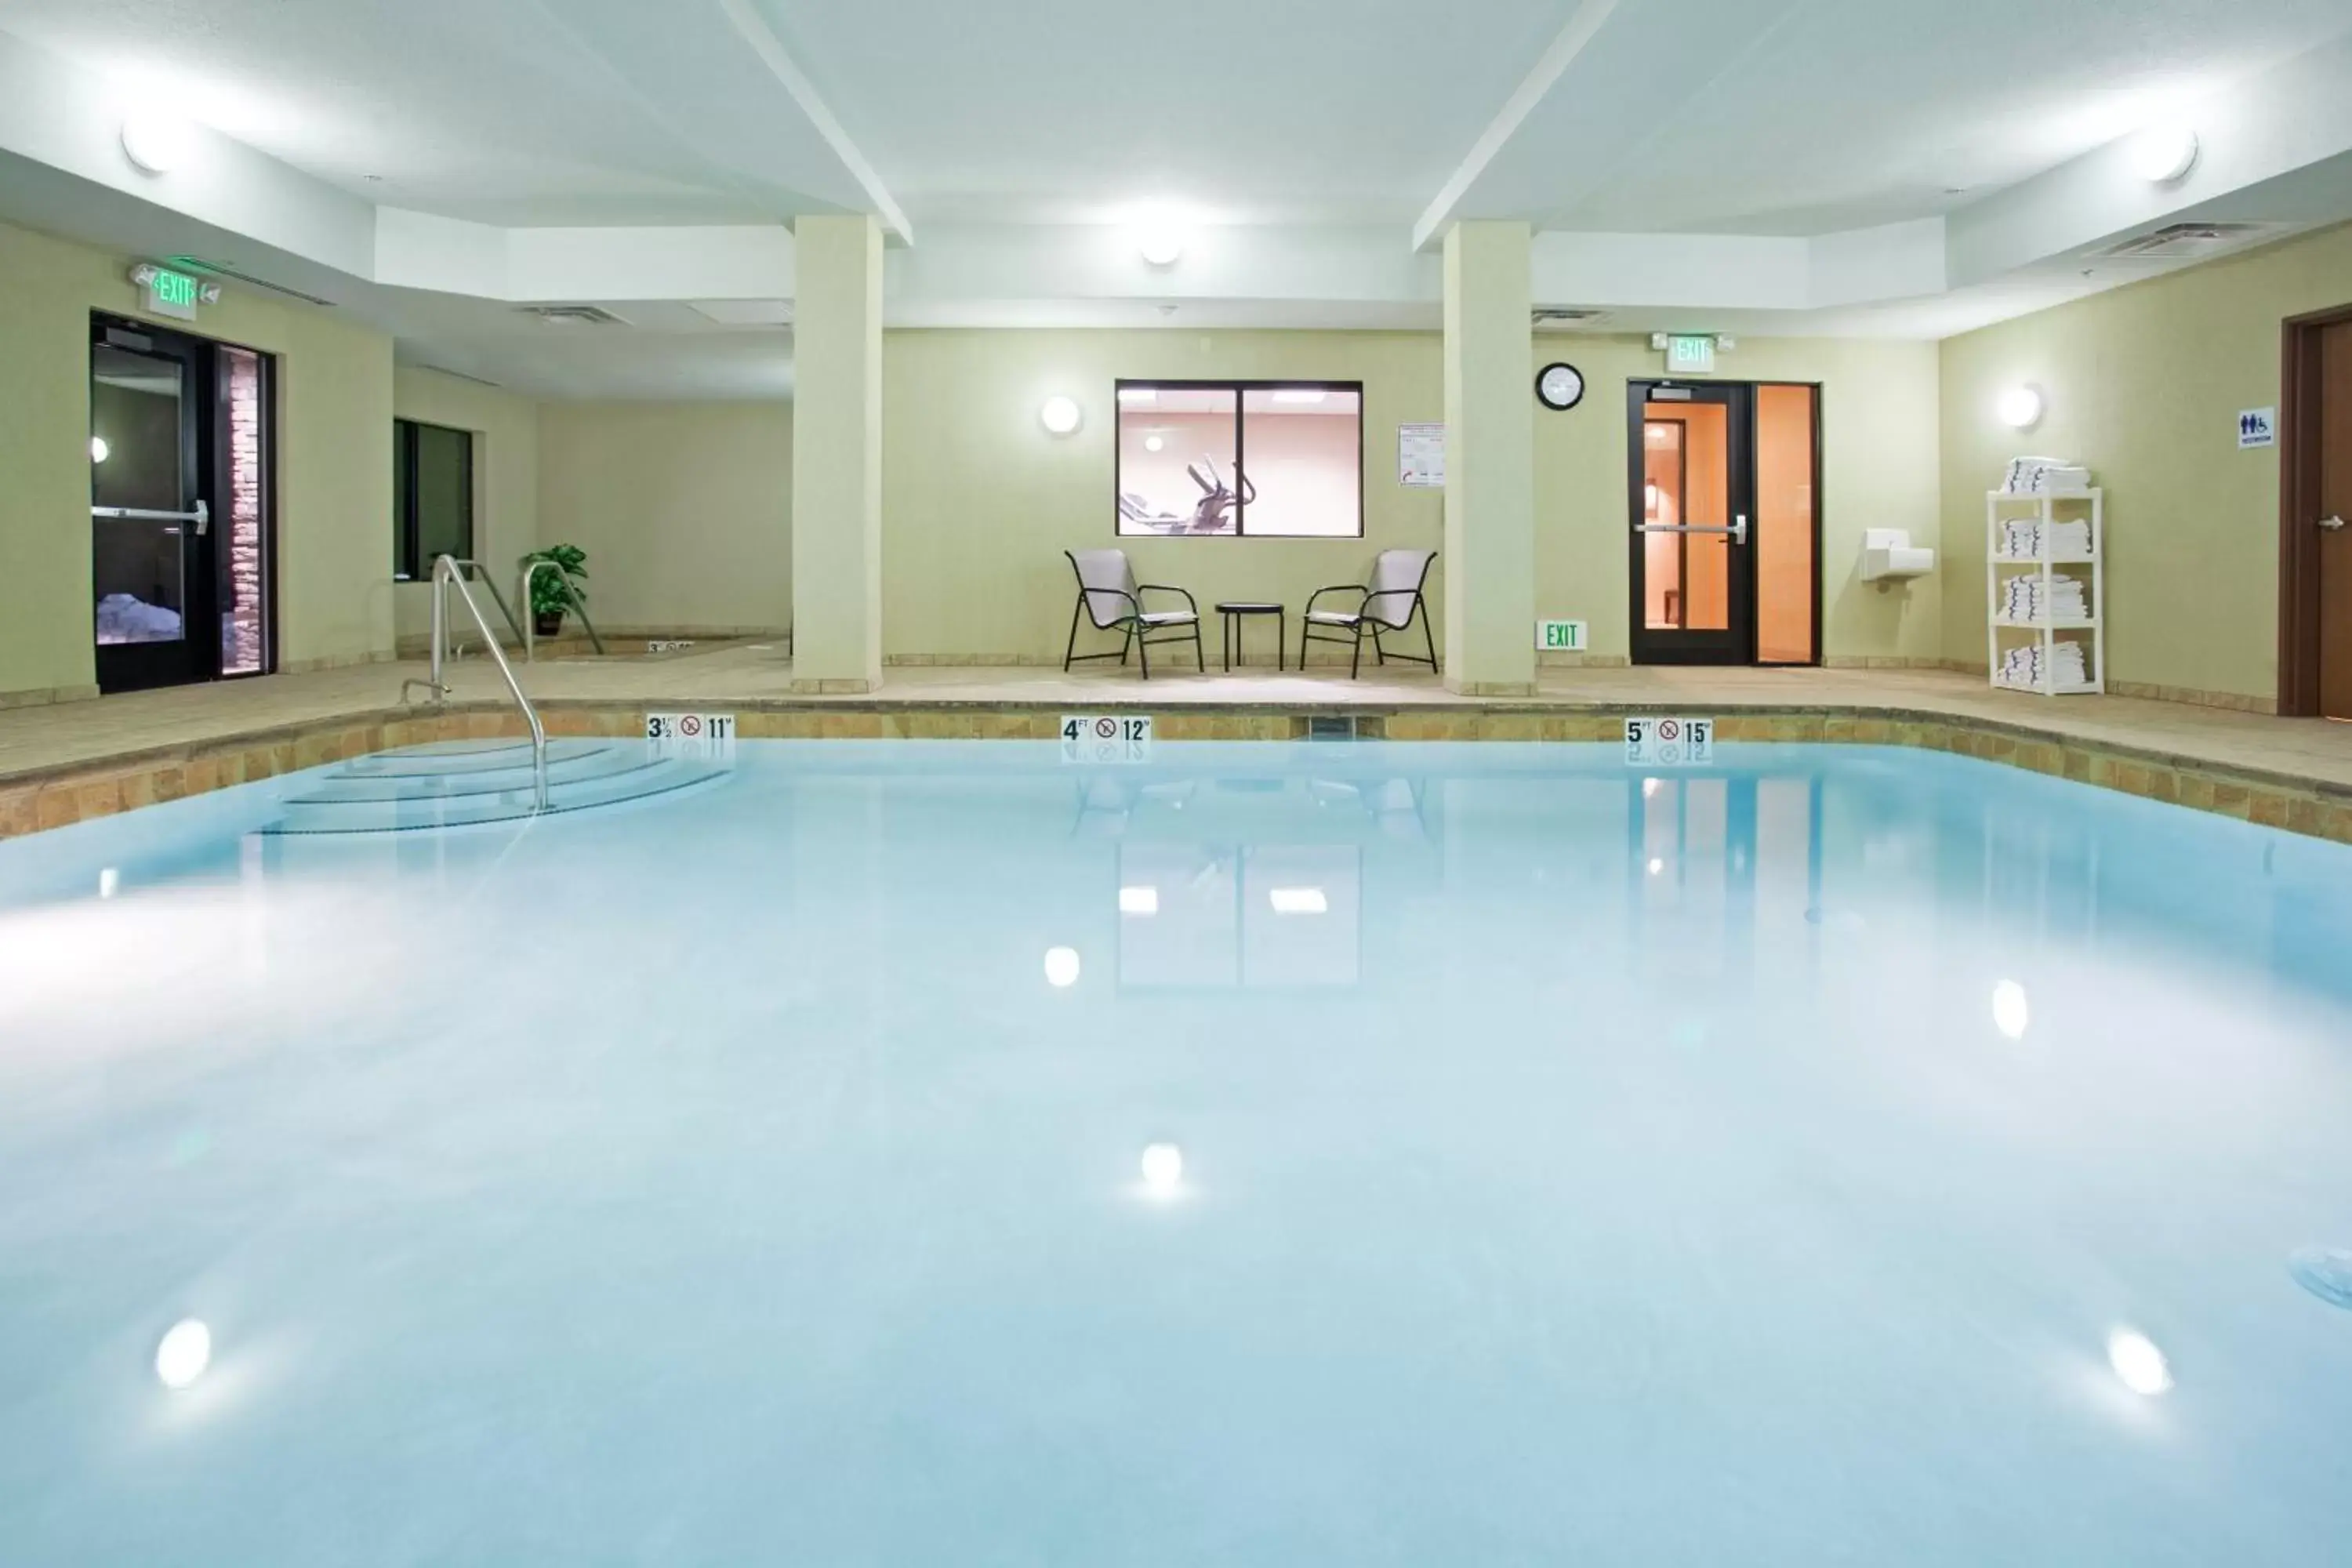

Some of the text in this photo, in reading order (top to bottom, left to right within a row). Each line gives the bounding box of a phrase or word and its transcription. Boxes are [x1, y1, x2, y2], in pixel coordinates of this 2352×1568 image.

[160, 270, 191, 307] EXIT
[1678, 338, 1707, 363] EXIT
[1547, 624, 1577, 647] EXIT
